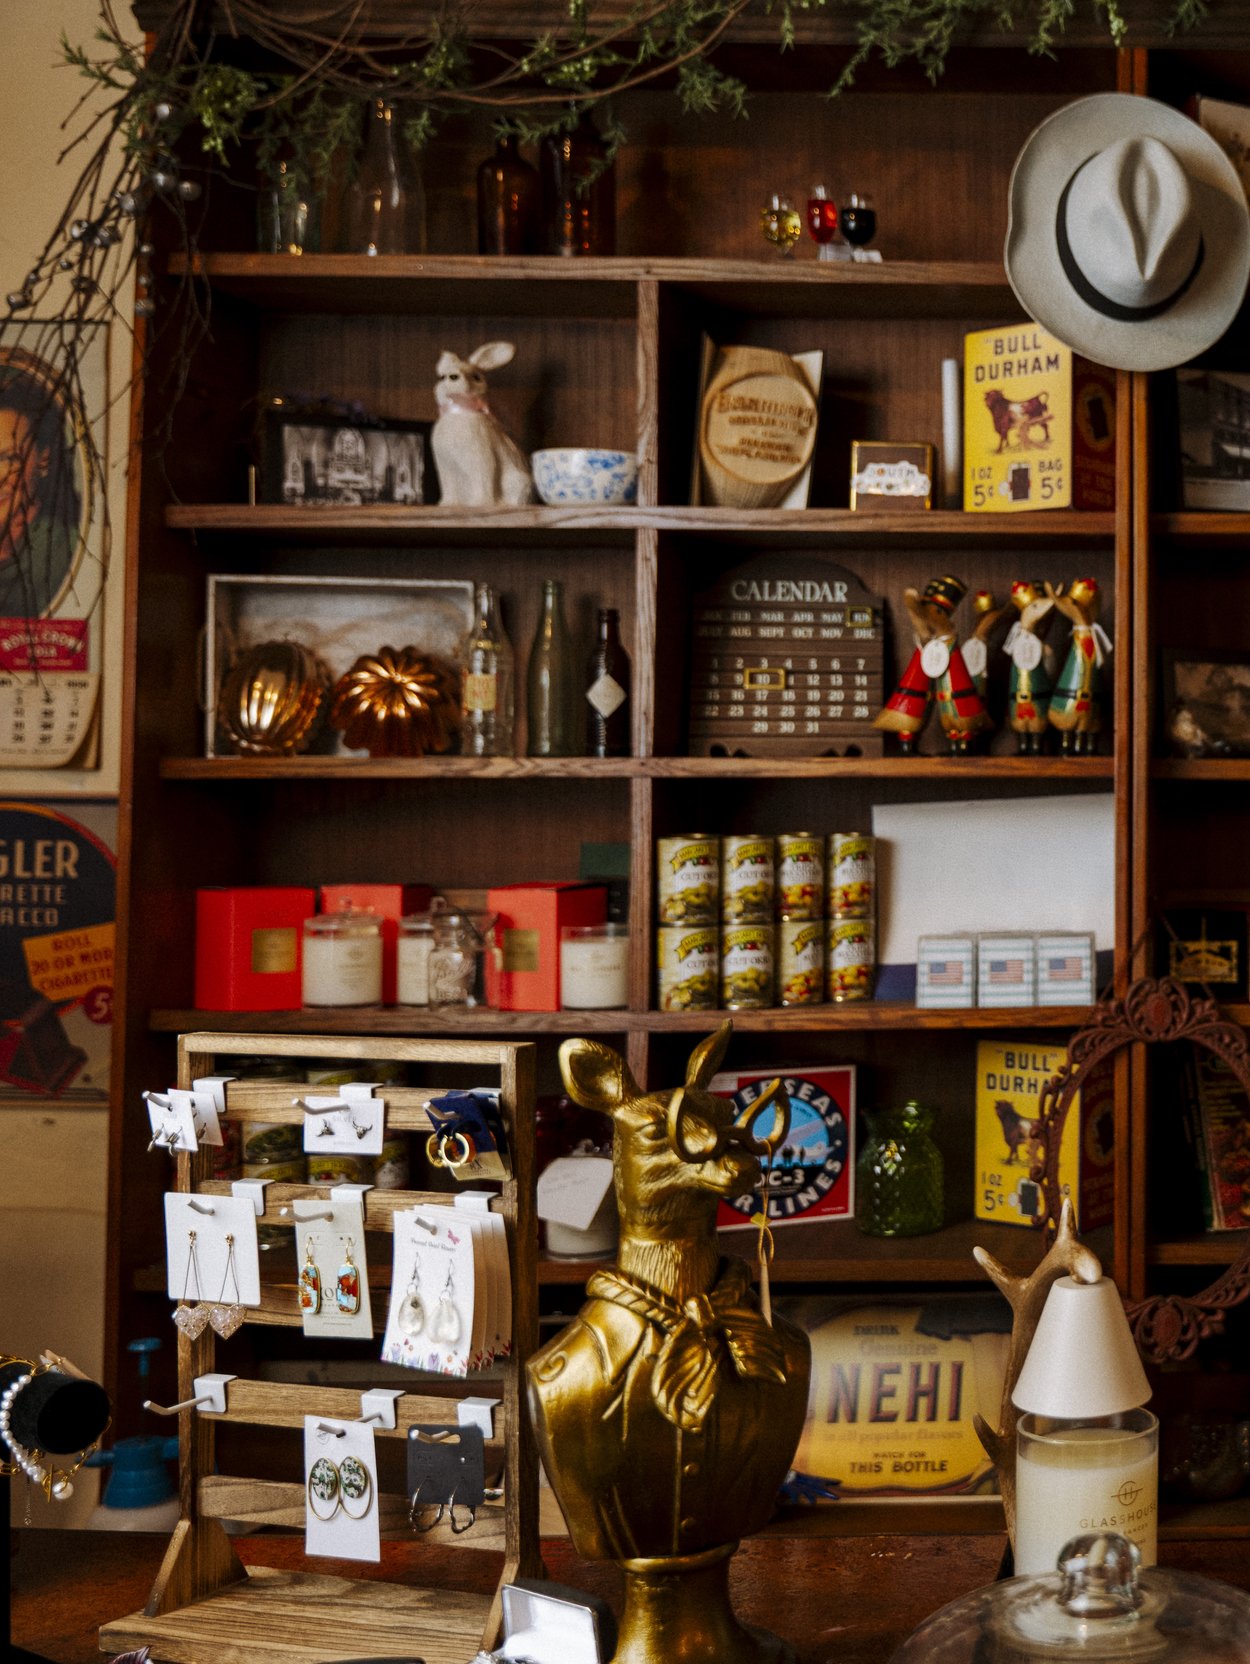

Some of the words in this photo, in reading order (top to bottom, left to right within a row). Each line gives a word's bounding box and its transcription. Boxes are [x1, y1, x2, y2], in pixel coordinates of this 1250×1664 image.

[974, 354, 1060, 383] DURHAM
[1038, 460, 1063, 473] BAG
[731, 580, 848, 602] CALENDAR
[761, 611, 784, 622] MAR
[792, 611, 814, 622] APR
[820, 611, 843, 622] MAY
[731, 627, 751, 637] AUG
[758, 627, 785, 638] SEPT
[792, 627, 814, 638] OCT
[820, 628, 843, 638] NOV
[735, 658, 744, 670] 2
[857, 658, 866, 670] 7
[755, 674, 770, 685] 10
[807, 674, 820, 685] 12
[828, 690, 844, 701] 20
[728, 705, 745, 718] 23
[752, 705, 768, 718] 24
[779, 705, 796, 718] 25
[827, 705, 844, 718] 27
[752, 721, 769, 733] 29
[779, 721, 796, 733] 30
[806, 721, 819, 733] 31
[986, 1072, 1050, 1094] DURH
[853, 1324, 900, 1336] DRINK
[827, 1360, 965, 1424] NEHI
[850, 1461, 883, 1474] THIS
[892, 1460, 949, 1473] BOTTLE
